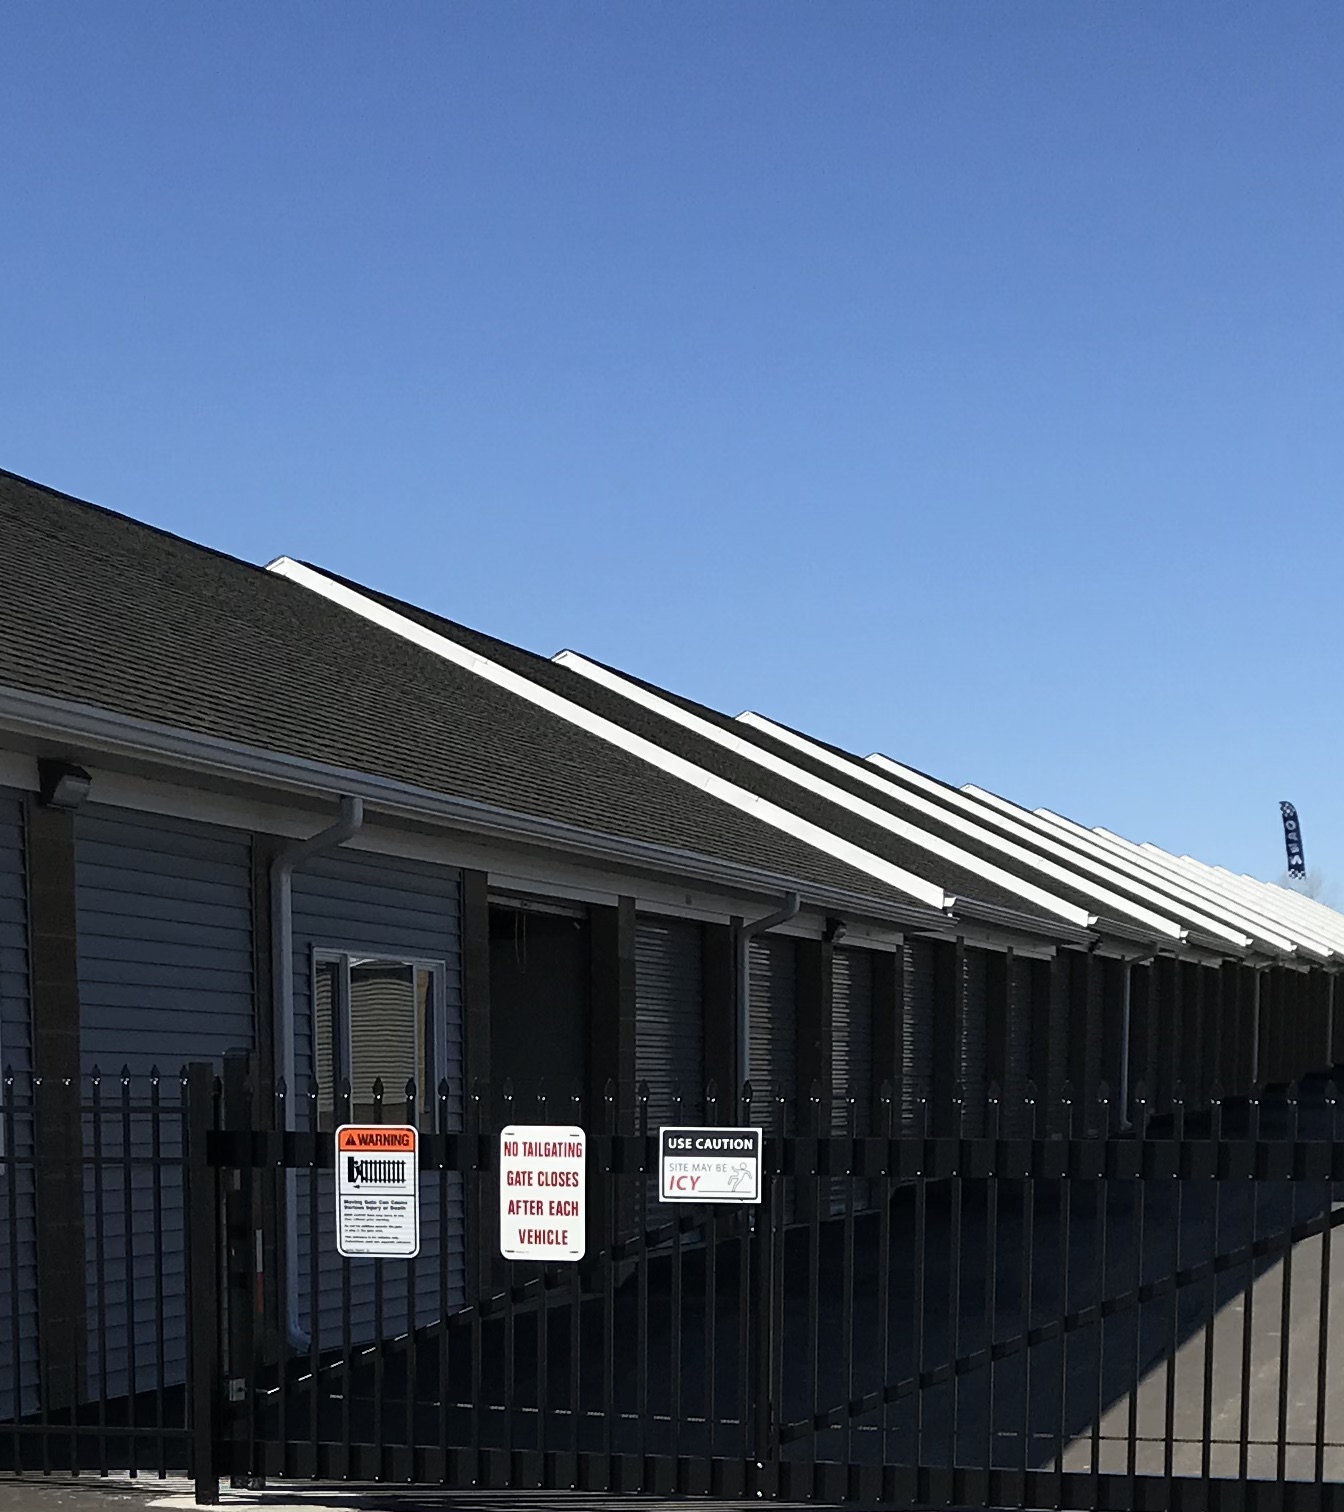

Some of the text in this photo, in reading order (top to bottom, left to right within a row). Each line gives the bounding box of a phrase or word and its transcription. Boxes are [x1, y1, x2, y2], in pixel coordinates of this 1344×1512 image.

[357, 1133, 410, 1146] WARNING
[668, 1137, 753, 1150] USE CAUTION
[504, 1141, 583, 1158] NO TAILGATING
[669, 1162, 728, 1173] SITE MAY BE
[507, 1170, 579, 1188] GATE CLOSES
[669, 1175, 701, 1191] ICY
[507, 1199, 579, 1217] AFTER EACH
[518, 1228, 568, 1246] VEHICLE
